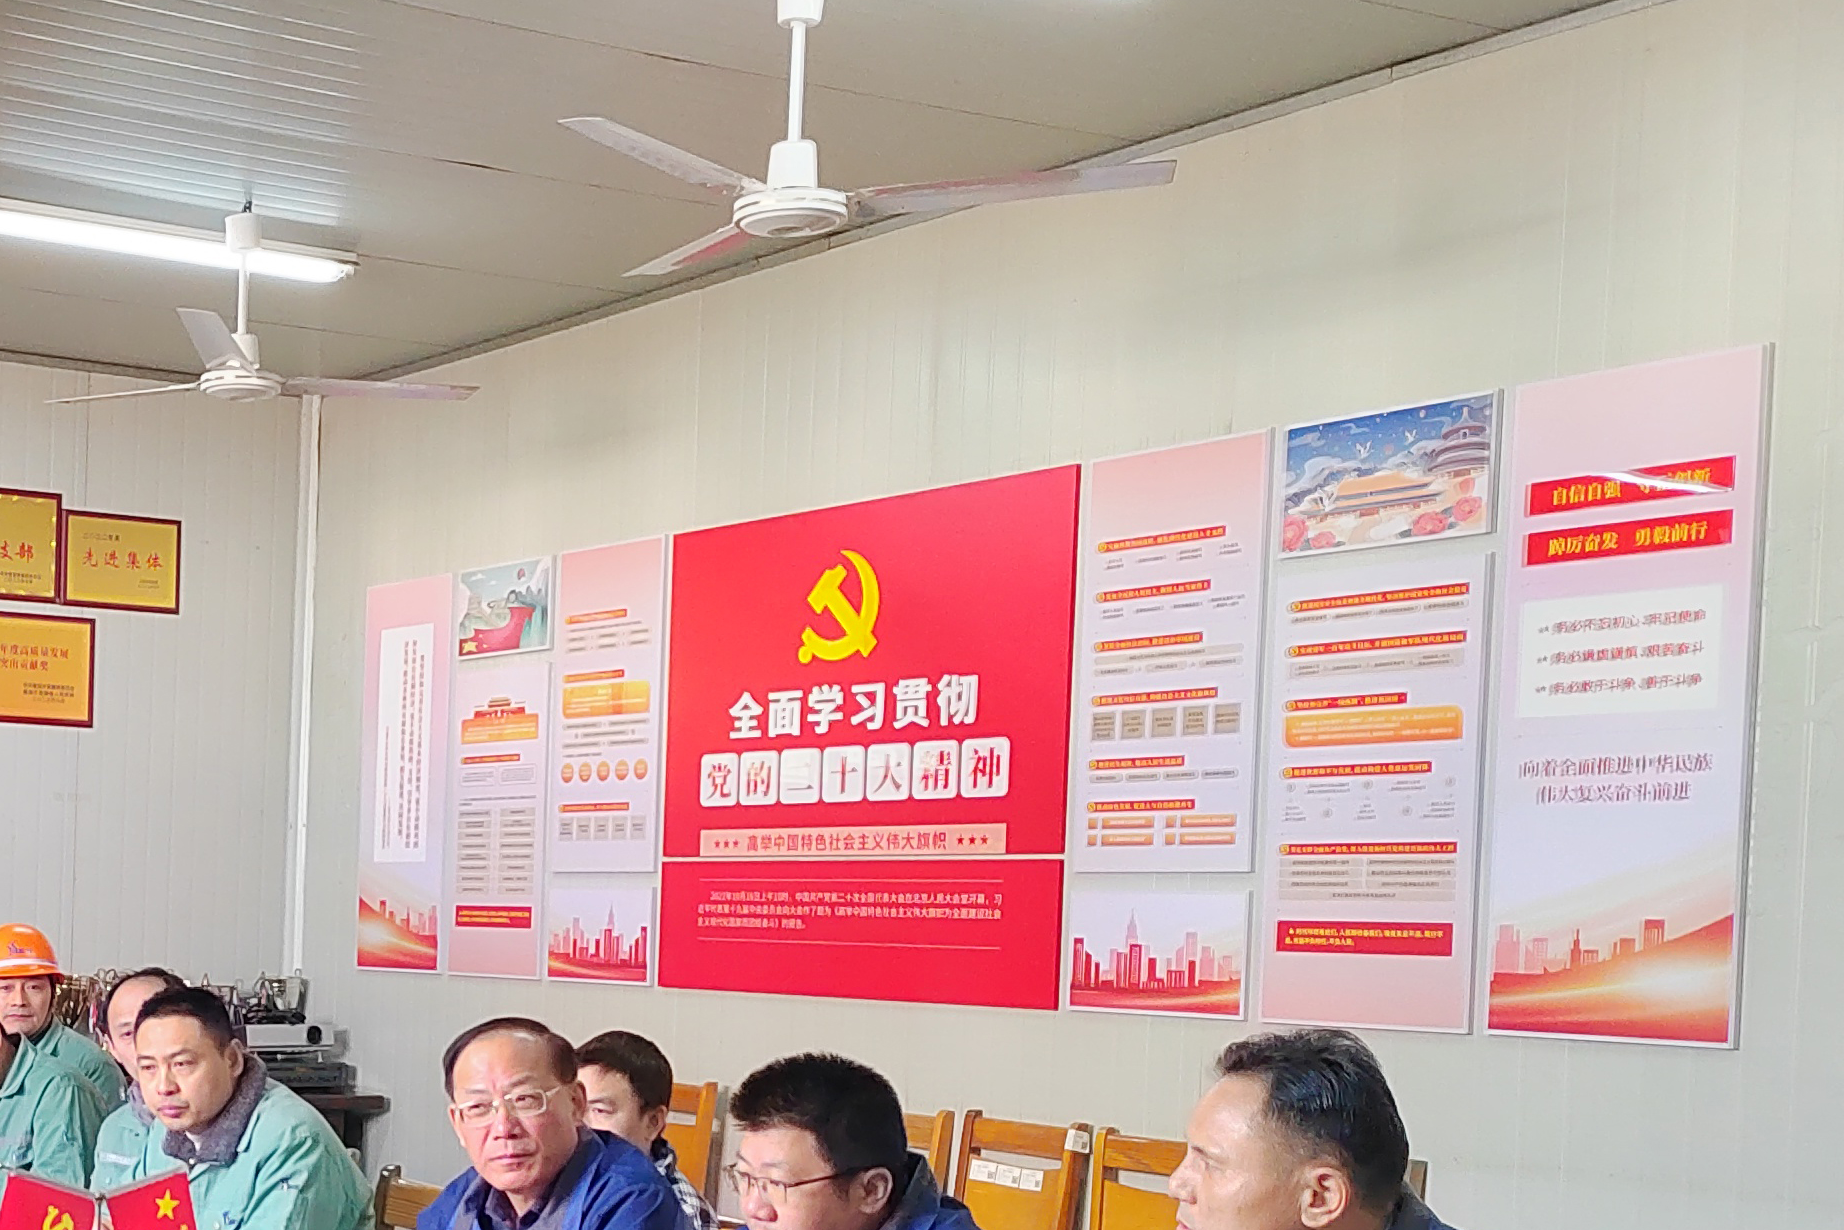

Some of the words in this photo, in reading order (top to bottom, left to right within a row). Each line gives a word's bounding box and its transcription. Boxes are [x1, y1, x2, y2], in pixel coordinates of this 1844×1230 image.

[1552, 480, 1622, 507] 自信自强
[1634, 520, 1709, 548] 勇毅前行
[82, 547, 164, 571] 先进集体
[729, 674, 980, 740] 全面学习贯彻
[706, 747, 1002, 799] 党的二十大精神
[1519, 752, 1714, 780] 向着全面推进中华民族
[1536, 781, 1692, 806] 伟大复兴奋斗前进
[747, 831, 947, 852] 高举中国特色社会主义伟大旗帜
